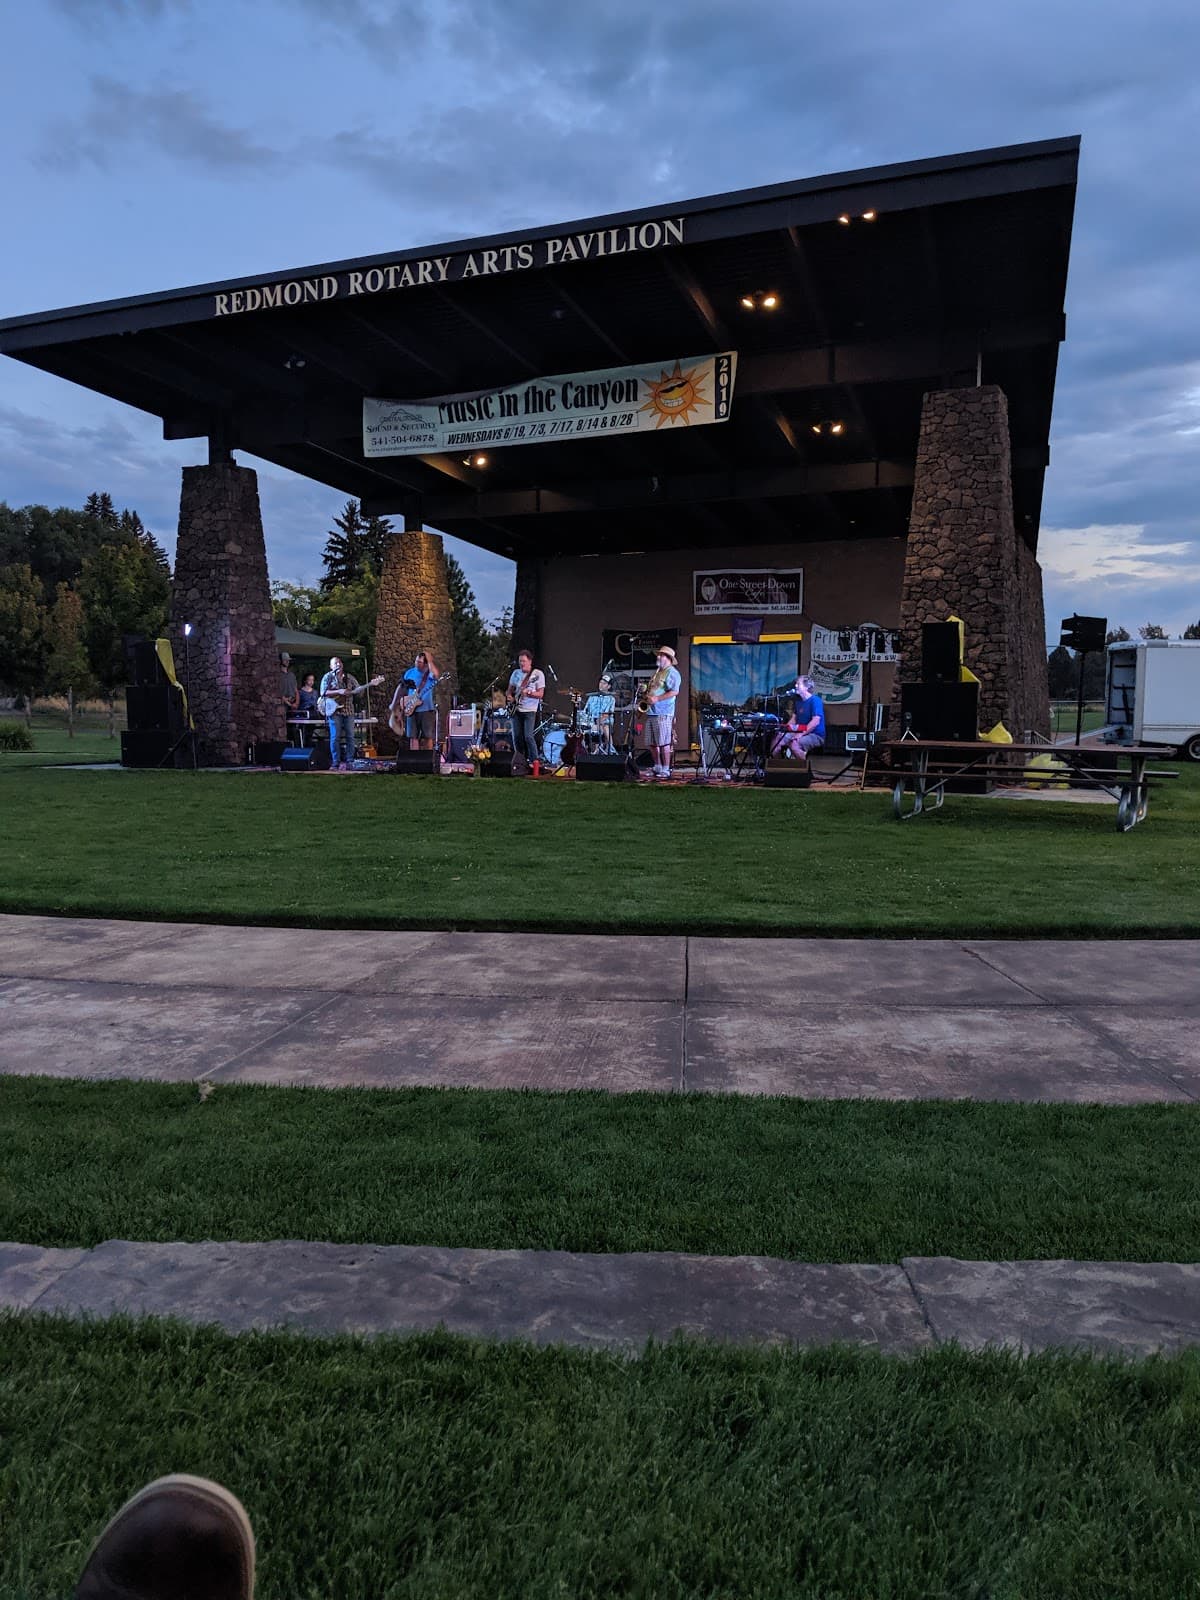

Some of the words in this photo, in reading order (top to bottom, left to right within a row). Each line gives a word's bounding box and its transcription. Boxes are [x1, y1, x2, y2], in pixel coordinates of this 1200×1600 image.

[214, 276, 338, 316] REDMOND
[348, 257, 450, 296] ROTARY
[462, 244, 533, 278] ARTS
[546, 218, 684, 265] PAVILION
[498, 390, 518, 418] in
[524, 385, 556, 414] the
[561, 378, 638, 411] Canyon
[719, 358, 729, 416] 2019
[447, 427, 503, 445] WEDNESDAYS
[504, 424, 526, 440] 6/19,
[529, 423, 546, 436] 7/3,
[549, 420, 573, 434] 7/17,
[576, 417, 599, 431] 8/14
[600, 416, 608, 428] &
[610, 413, 633, 427] 8/28
